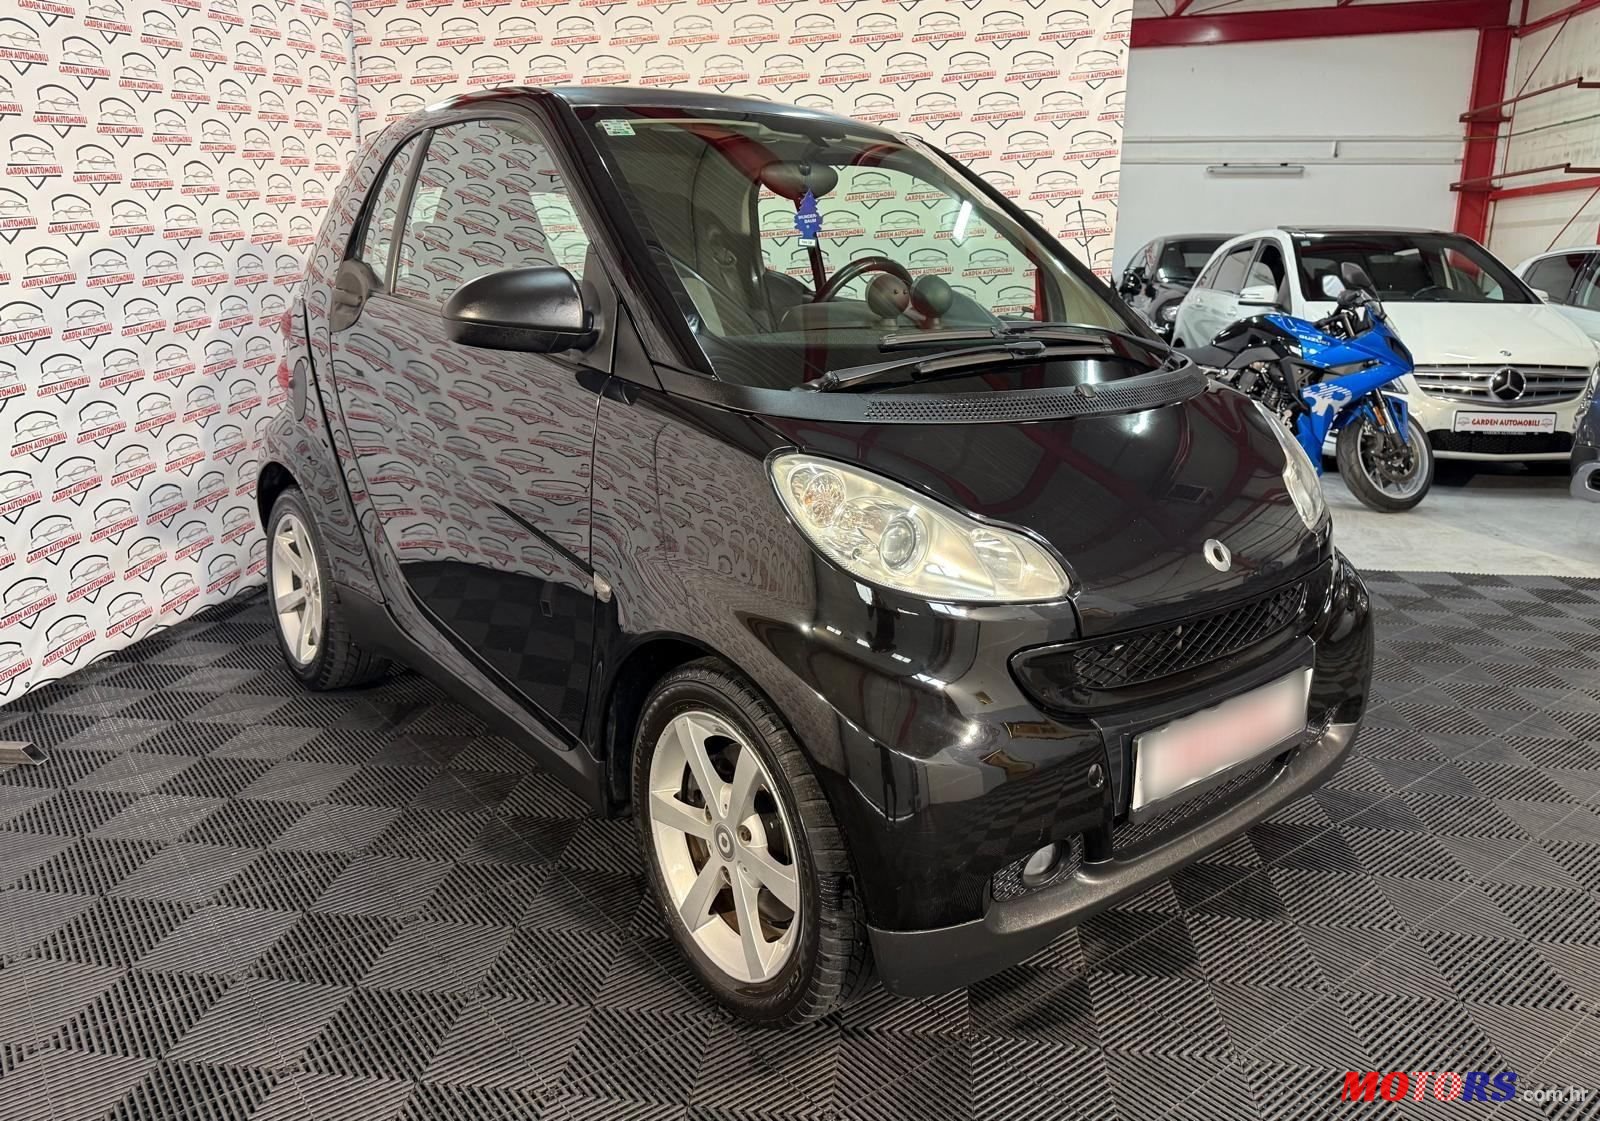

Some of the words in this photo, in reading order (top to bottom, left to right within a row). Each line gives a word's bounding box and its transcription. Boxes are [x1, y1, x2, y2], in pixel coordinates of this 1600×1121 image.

[17, 0, 40, 9] GARDEN
[41, 3, 75, 14] AUTOMOBILI
[84, 20, 102, 29] GARDEN
[103, 22, 133, 33] AUTOMOBILI
[379, 39, 398, 49] GARDEN
[400, 35, 428, 46] AUTOMOBILI
[493, 39, 512, 47] GARDEN
[513, 34, 542, 44] AUTOMOBILI
[550, 37, 569, 47] GARDEN
[571, 33, 601, 44] AUTOMOBILI
[668, 37, 687, 47] GARDEN
[688, 33, 720, 44] AUTOMOBILI
[727, 36, 747, 46] GARDEN
[748, 32, 780, 44] AUTOMOBILI
[788, 36, 808, 46] GARDEN
[809, 32, 842, 43] AUTOMOBILI
[848, 35, 870, 45] GARDEN
[871, 31, 903, 42] AUTOMOBILI
[910, 35, 932, 44] GARDEN
[933, 30, 966, 41] AUTOMOBILI
[974, 34, 995, 42] GARDEN
[997, 29, 1032, 40] AUTOMOBILI
[1038, 33, 1060, 42] GARDEN
[1061, 28, 1094, 39] AUTOMOBILI
[58, 66, 79, 74] GARDEN
[80, 67, 110, 76] AUTOMOBILI
[817, 76, 838, 85] GARDEN
[839, 71, 871, 82] AUTOMOBILI
[879, 75, 899, 84] GARDEN
[901, 70, 933, 81] AUTOMOBILI
[941, 74, 962, 83] GARDEN
[963, 69, 997, 80] AUTOMOBILI
[1003, 73, 1025, 83] GARDEN
[1026, 68, 1060, 80] AUTOMOBILI
[410, 77, 428, 86] GARDEN
[430, 73, 459, 84] AUTOMOBILI
[698, 76, 717, 85] GARDEN
[718, 72, 749, 83] AUTOMOBILI
[757, 75, 777, 86] GARDEN
[778, 71, 811, 83] AUTOMOBILI
[868, 112, 900, 121] AUTOMOBILI
[910, 114, 928, 123] GARDEN
[930, 109, 961, 121] AUTOMOBILI
[970, 114, 991, 122] GARDEN
[992, 110, 1024, 120] AUTOMOBILI
[1034, 113, 1054, 122] GARDEN
[1055, 109, 1088, 120] AUTOMOBILI
[959, 150, 992, 159] AUTOMOBILI
[1000, 153, 1020, 161] GARDEN
[1021, 149, 1054, 159] AUTOMOBILI
[1063, 153, 1084, 161] GARDEN
[1085, 148, 1119, 158] AUTOMOBILI
[5, 167, 28, 175] GARDEN
[29, 166, 63, 174] AUTOMOBILI
[73, 174, 92, 182] GARDEN
[93, 173, 122, 181] AUTOMOBILI
[844, 193, 864, 202] GARDEN
[865, 190, 896, 200] AUTOMOBILI
[1028, 192, 1049, 201] GARDEN
[1050, 188, 1084, 198] AUTOMOBILI
[3, 217, 38, 228] AUTOMOBILI
[47, 224, 68, 234] GARDEN
[69, 221, 99, 232] AUTOMOBILI
[875, 230, 893, 240] GARDEN
[894, 227, 925, 238] AUTOMOBILI
[960, 269, 981, 279] GARDEN
[982, 265, 1014, 276] AUTOMOBILI
[21, 278, 43, 288] GARDEN
[44, 273, 76, 285] AUTOMOBILI
[86, 277, 105, 288] GARDEN
[106, 273, 135, 284] AUTOMOBILI
[18, 327, 52, 341] AUTOMOBILI
[61, 330, 81, 341] GARDEN
[82, 323, 112, 336] AUTOMOBILI
[36, 385, 58, 397] GARDEN
[59, 375, 91, 391] AUTOMOBILI
[1471, 418, 1499, 426] GARDEN
[1499, 419, 1540, 427] AUTOMOBILI
[76, 431, 96, 444] GARDEN
[97, 421, 126, 437] AUTOMOBILI
[9, 444, 32, 457] GARDEN
[34, 432, 67, 448] AUTOMOBILI
[51, 488, 71, 503] GARDEN
[73, 475, 102, 494] AUTOMOBILI
[8, 490, 42, 512] AUTOMOBILI
[89, 529, 109, 543] GARDEN
[110, 516, 138, 533] AUTOMOBILI
[25, 548, 48, 564] GARDEN
[49, 532, 82, 553] AUTOMOBILI
[67, 587, 85, 603] GARDEN
[87, 571, 116, 592] AUTOMOBILI
[0, 612, 22, 629] GARDEN
[23, 594, 57, 617] AUTOMOBILI
[105, 623, 124, 638] GARDEN
[125, 606, 153, 627] AUTOMOBILI
[42, 648, 63, 667] GARDEN
[64, 629, 96, 654] AUTOMOBILI
